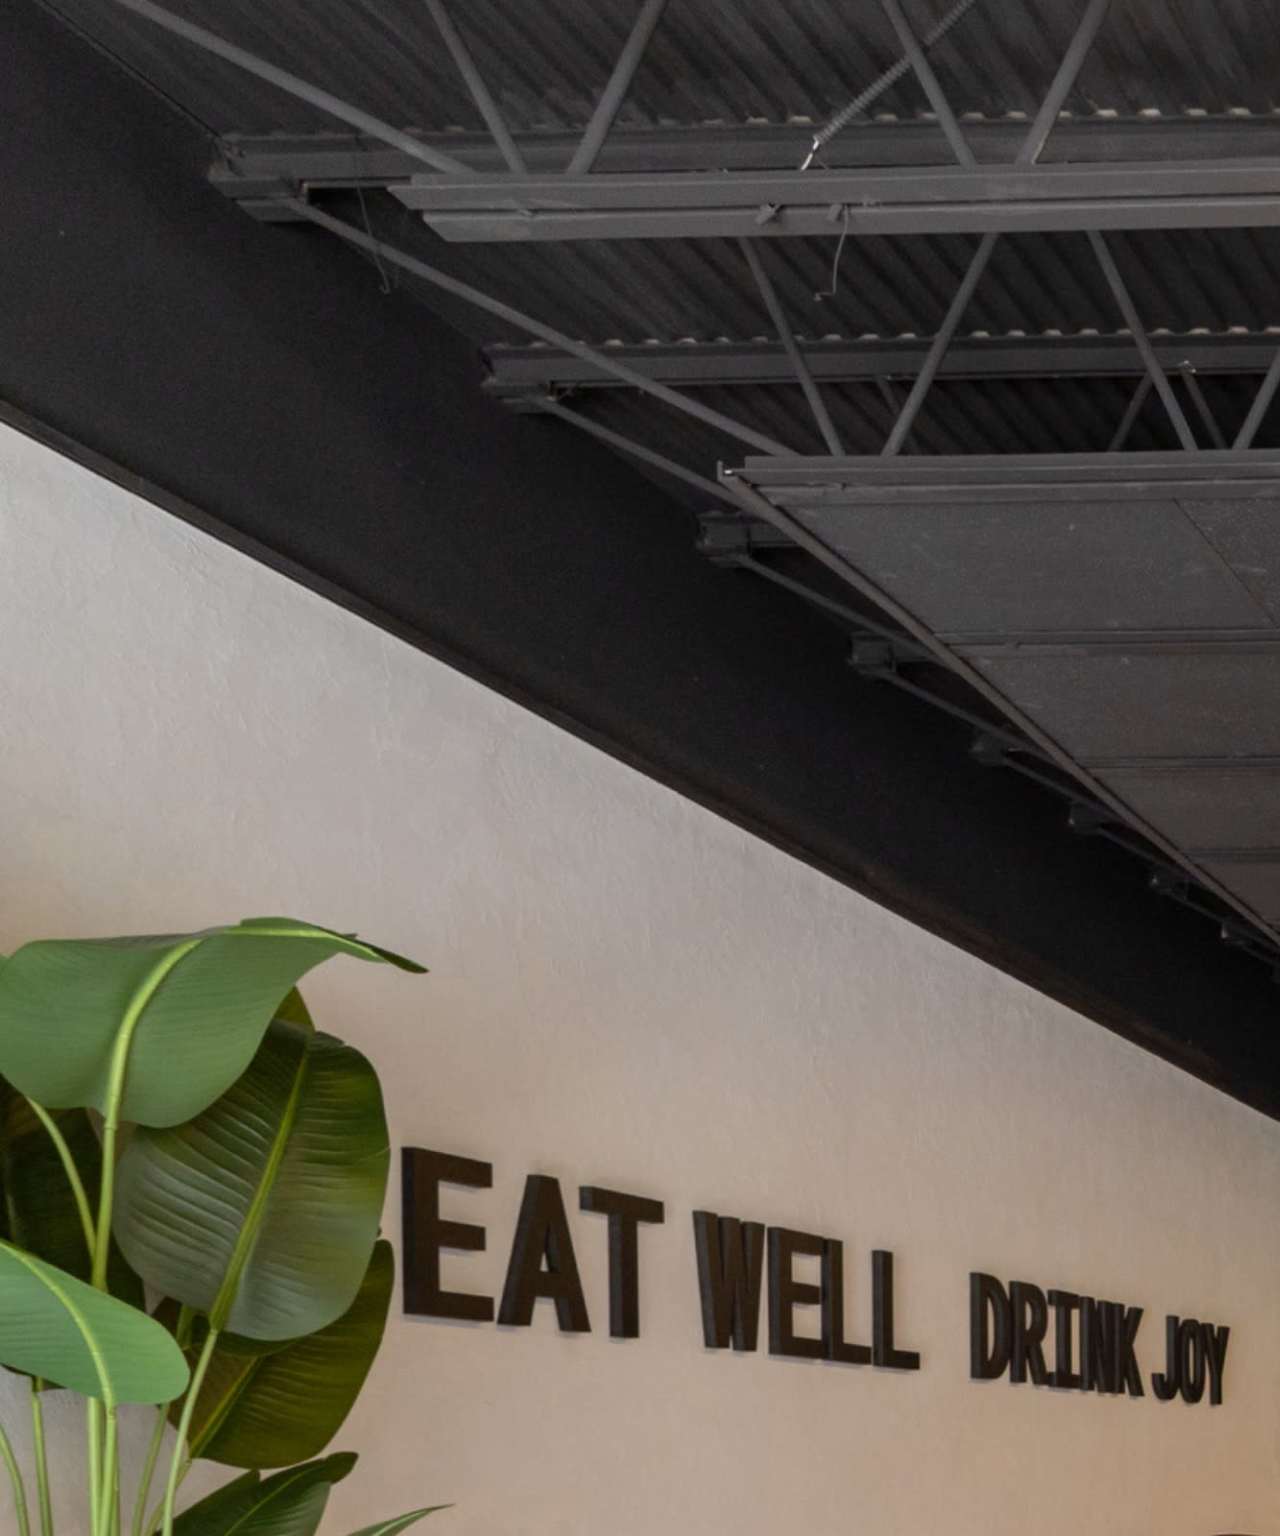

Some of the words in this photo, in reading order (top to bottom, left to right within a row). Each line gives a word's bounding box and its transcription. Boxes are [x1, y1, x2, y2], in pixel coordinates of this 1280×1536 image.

[402, 1146, 664, 1338] EAT
[693, 1209, 920, 1369] WELL
[970, 1271, 1144, 1396] DRINK
[1151, 1315, 1230, 1405] JOY
